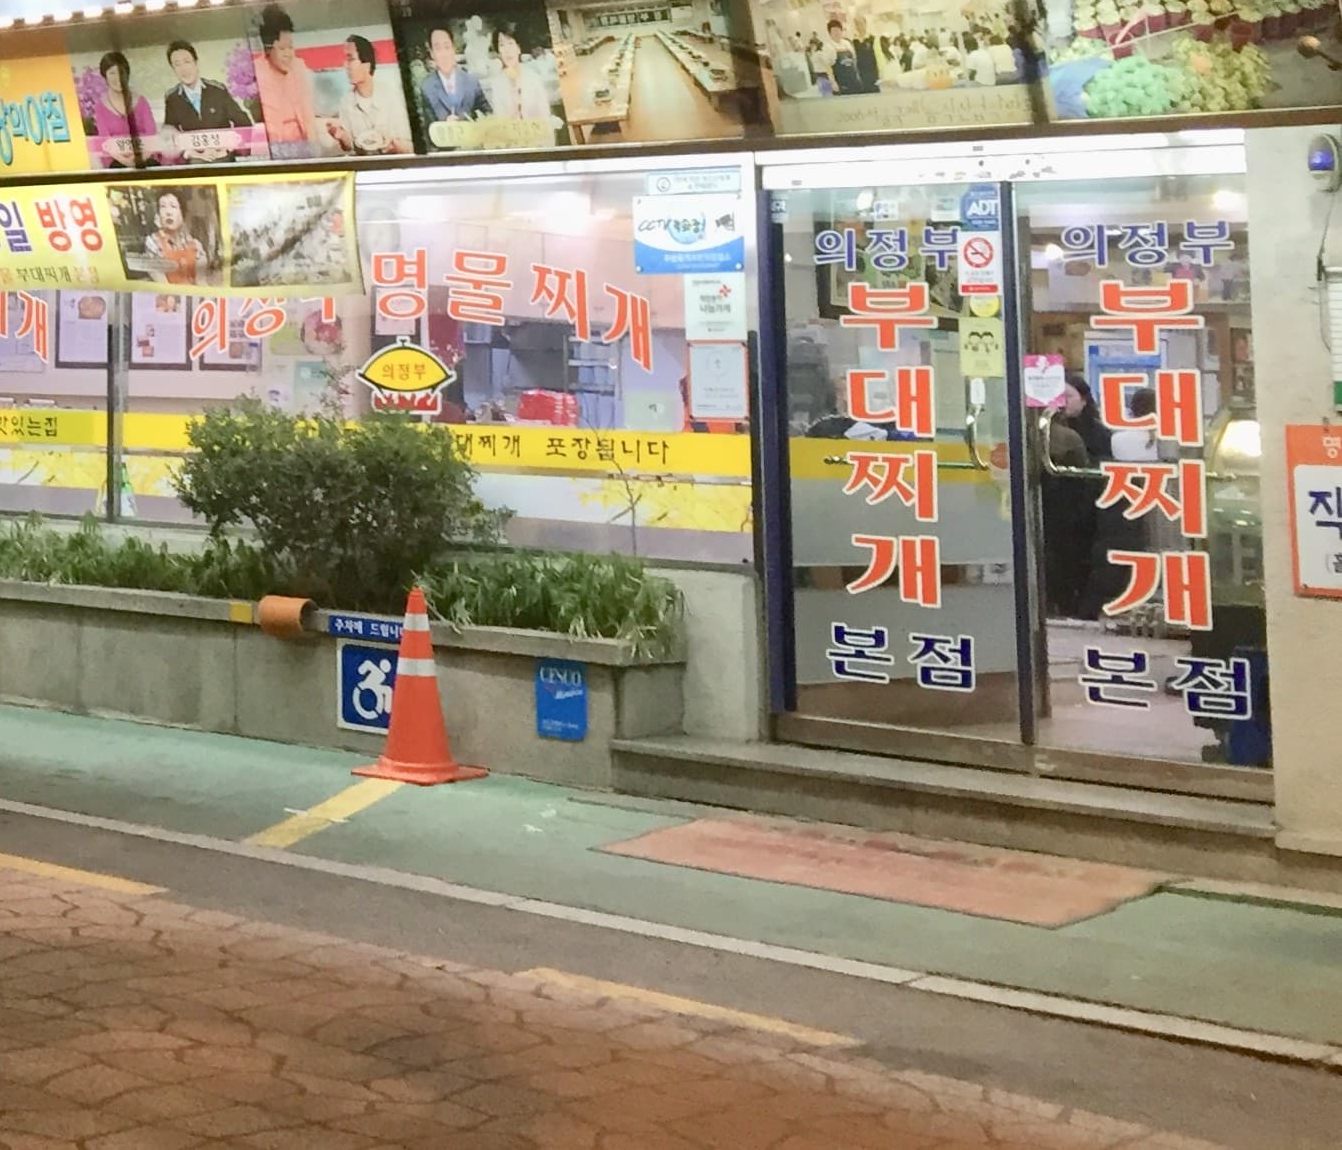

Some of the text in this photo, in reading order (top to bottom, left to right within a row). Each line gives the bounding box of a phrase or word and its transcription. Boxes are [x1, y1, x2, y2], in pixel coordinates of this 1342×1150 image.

[33, 196, 104, 252] 방영
[966, 200, 998, 217] ADT
[814, 226, 961, 271] 의정부
[1061, 219, 1235, 268] 의정부
[370, 247, 656, 376] 명물찌개
[380, 362, 427, 381] 의정부
[545, 434, 671, 464] 포장됩니다
[839, 281, 942, 609] 부대찌개
[1090, 278, 1215, 631] 부대찌개
[370, 622, 404, 640] 드립니
[826, 622, 976, 693] 본점
[1078, 646, 1254, 721] 본점
